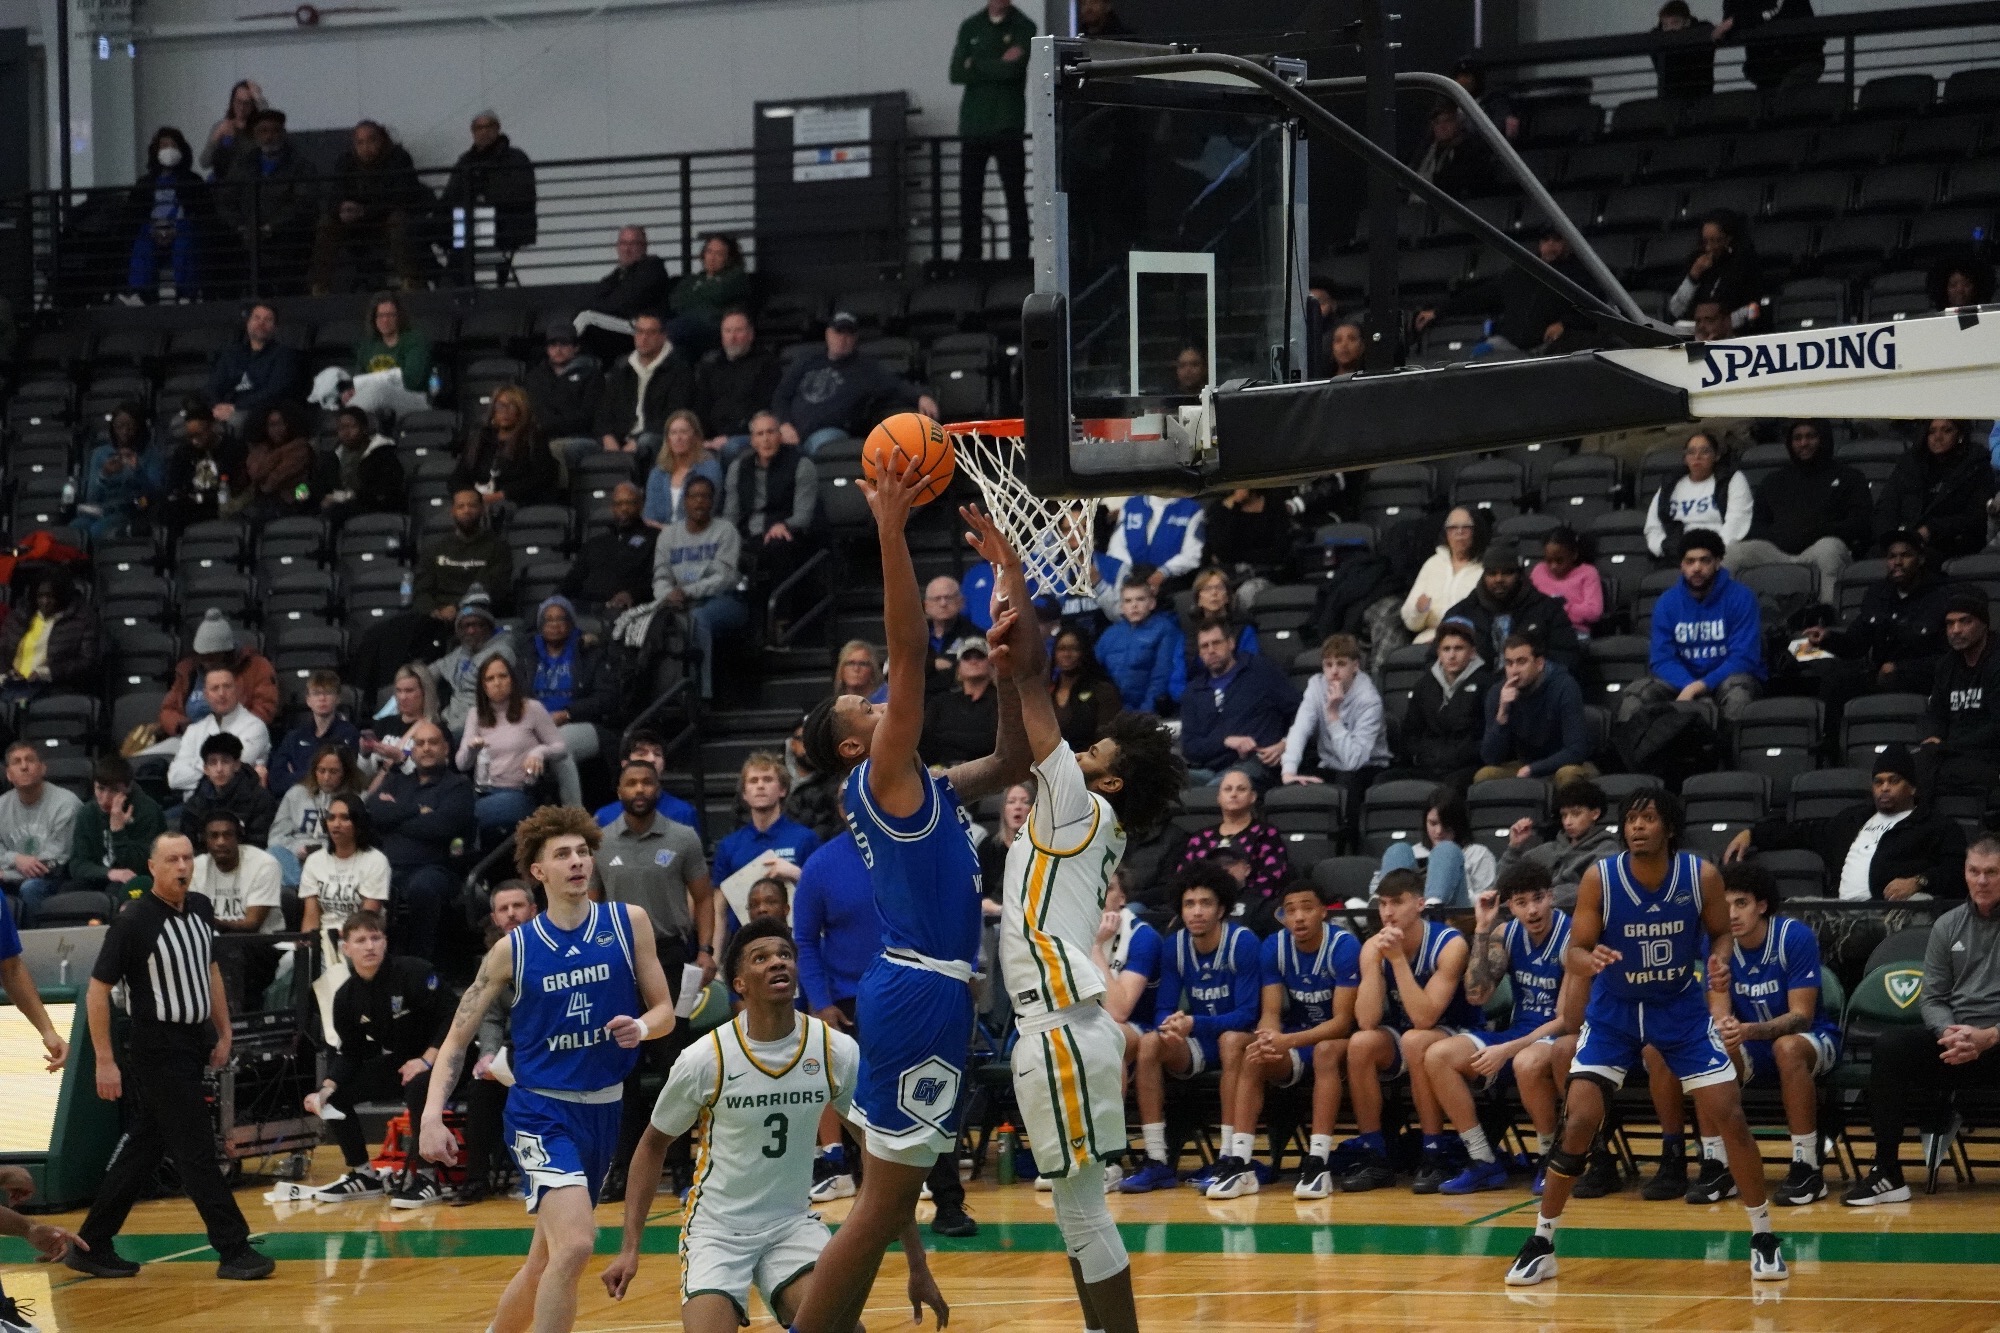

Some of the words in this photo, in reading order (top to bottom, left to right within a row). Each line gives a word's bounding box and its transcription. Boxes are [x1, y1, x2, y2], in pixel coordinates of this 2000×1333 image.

[1701, 325, 1896, 388] SPALDING
[1669, 496, 1719, 518] GVS
[1675, 619, 1725, 643] GVSU
[1624, 920, 1684, 938] GRAND
[1638, 939, 1672, 969] 10
[542, 963, 610, 993] GRAND
[1625, 966, 1687, 985] VALLEY
[565, 991, 594, 1026] 4
[547, 1026, 612, 1052] VALLEY
[726, 1090, 824, 1109] WARRIORS
[912, 1077, 948, 1106] GV
[762, 1112, 789, 1159] 3
